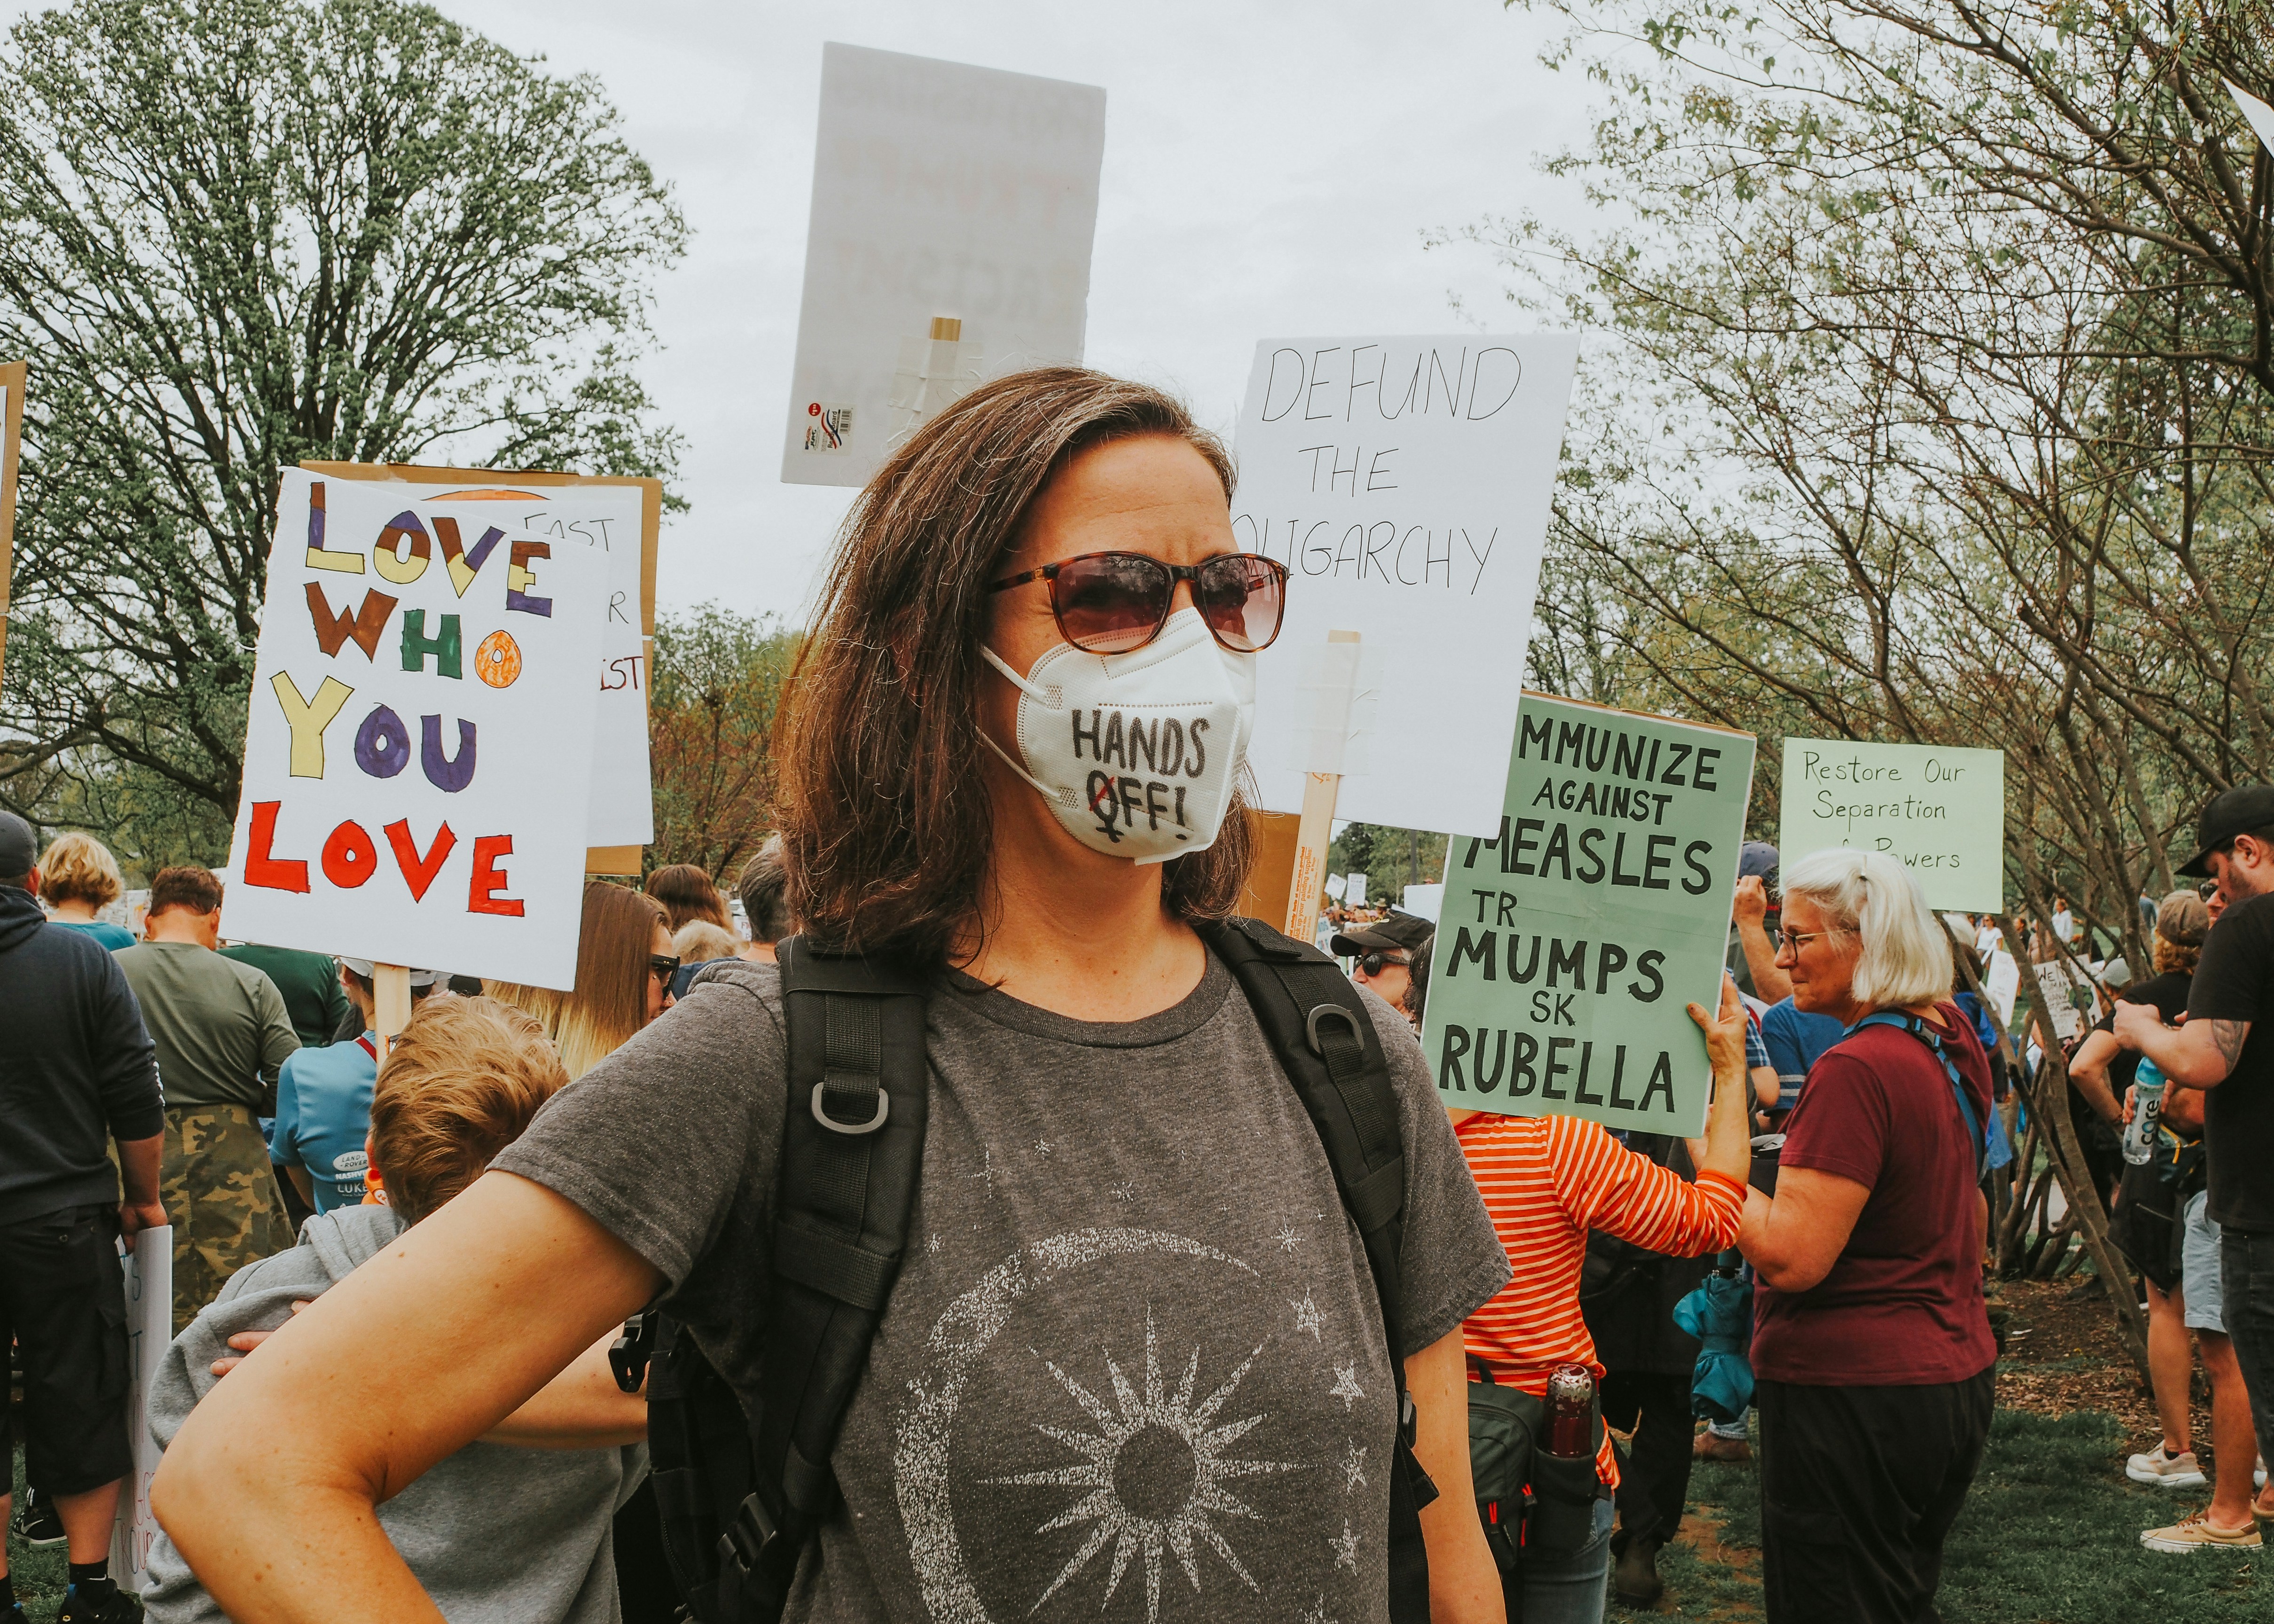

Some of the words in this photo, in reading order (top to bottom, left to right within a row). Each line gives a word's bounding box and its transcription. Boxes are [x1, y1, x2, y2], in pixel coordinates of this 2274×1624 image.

[1262, 344, 1521, 422] DEFUND
[1298, 445, 1399, 497] THE
[306, 482, 552, 617] LOVE
[303, 581, 522, 688] WHO
[270, 670, 477, 793] YOU
[1072, 709, 1210, 778] HANDS
[1518, 714, 1722, 792] MMUNIZE
[1803, 751, 1902, 785] Restore
[1925, 759, 1966, 783] Our
[1086, 769, 1188, 843] OFF!
[1531, 777, 1673, 825] AGAINST
[1812, 790, 1945, 832] Separation
[244, 800, 525, 917] LOVE
[1301, 876, 1309, 901] painting
[1464, 816, 1713, 895] MEASLES
[1875, 838, 1960, 868] Pwers
[1471, 889, 1517, 928] TR
[1446, 927, 1666, 1003] MUMPS
[1529, 991, 1576, 1026] SK
[1438, 1024, 1675, 1114] RUBELLA
